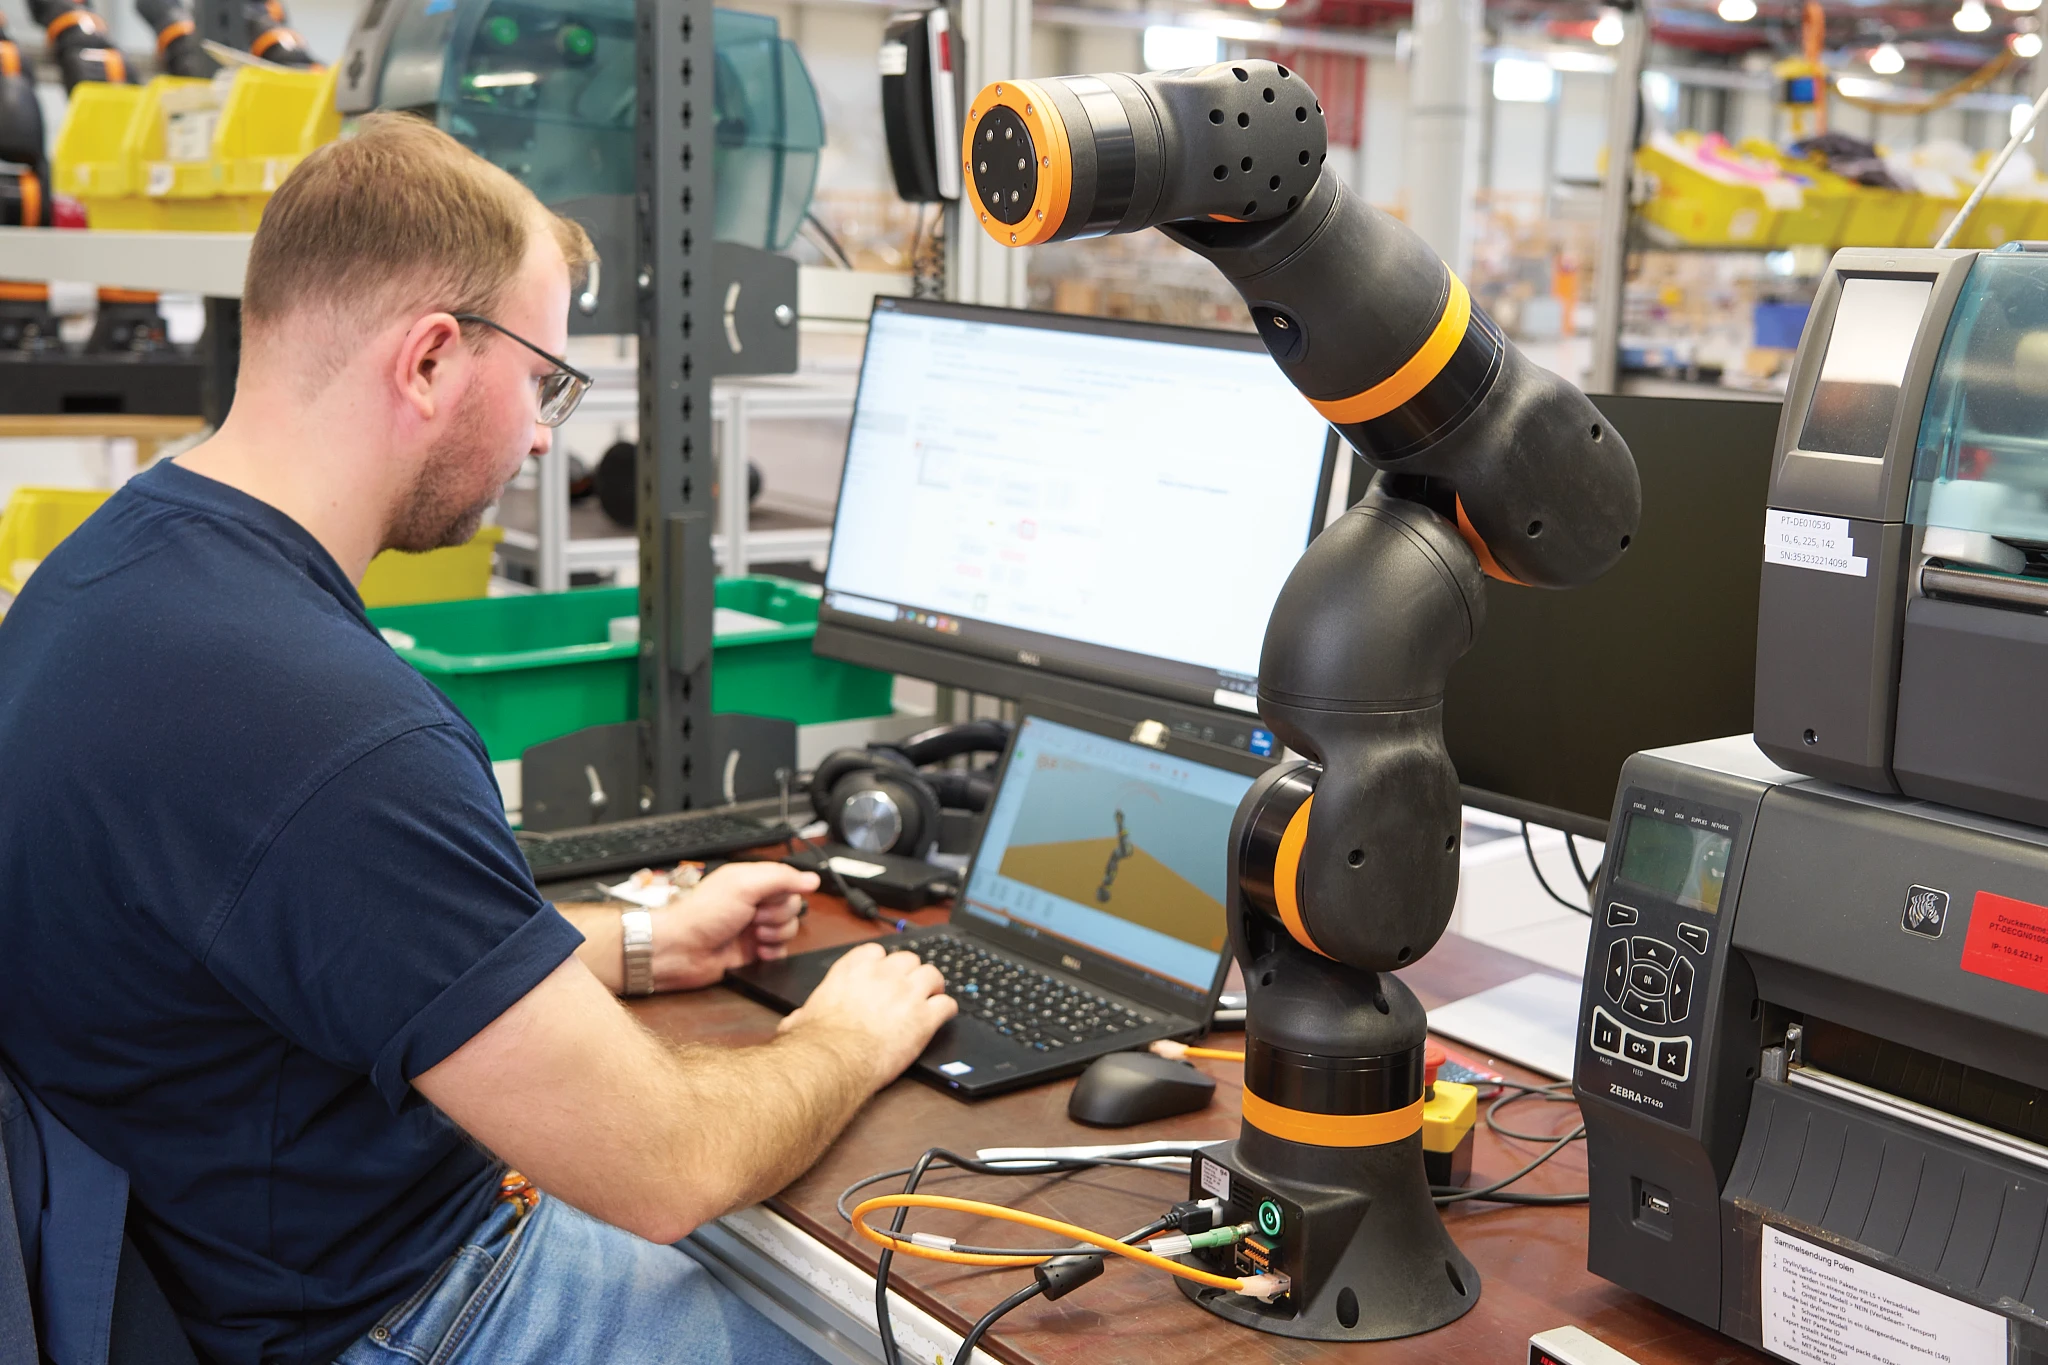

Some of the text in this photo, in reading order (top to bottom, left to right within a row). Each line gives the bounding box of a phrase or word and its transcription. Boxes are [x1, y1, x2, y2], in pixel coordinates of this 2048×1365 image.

[1781, 516, 1830, 530] PT-DE010530
[1780, 551, 1848, 568] SN:353232214098
[2004, 946, 2043, 963] 10.6.221.21
[1644, 974, 1652, 985] OK
[1600, 1056, 1612, 1066] PAUSE
[1633, 1068, 1643, 1076] FEED
[1661, 1079, 1677, 1090] CANCEL
[1610, 1083, 1663, 1108] ZEBRA ZT420
[1774, 1236, 1854, 1274] Sammelsendung Polen
